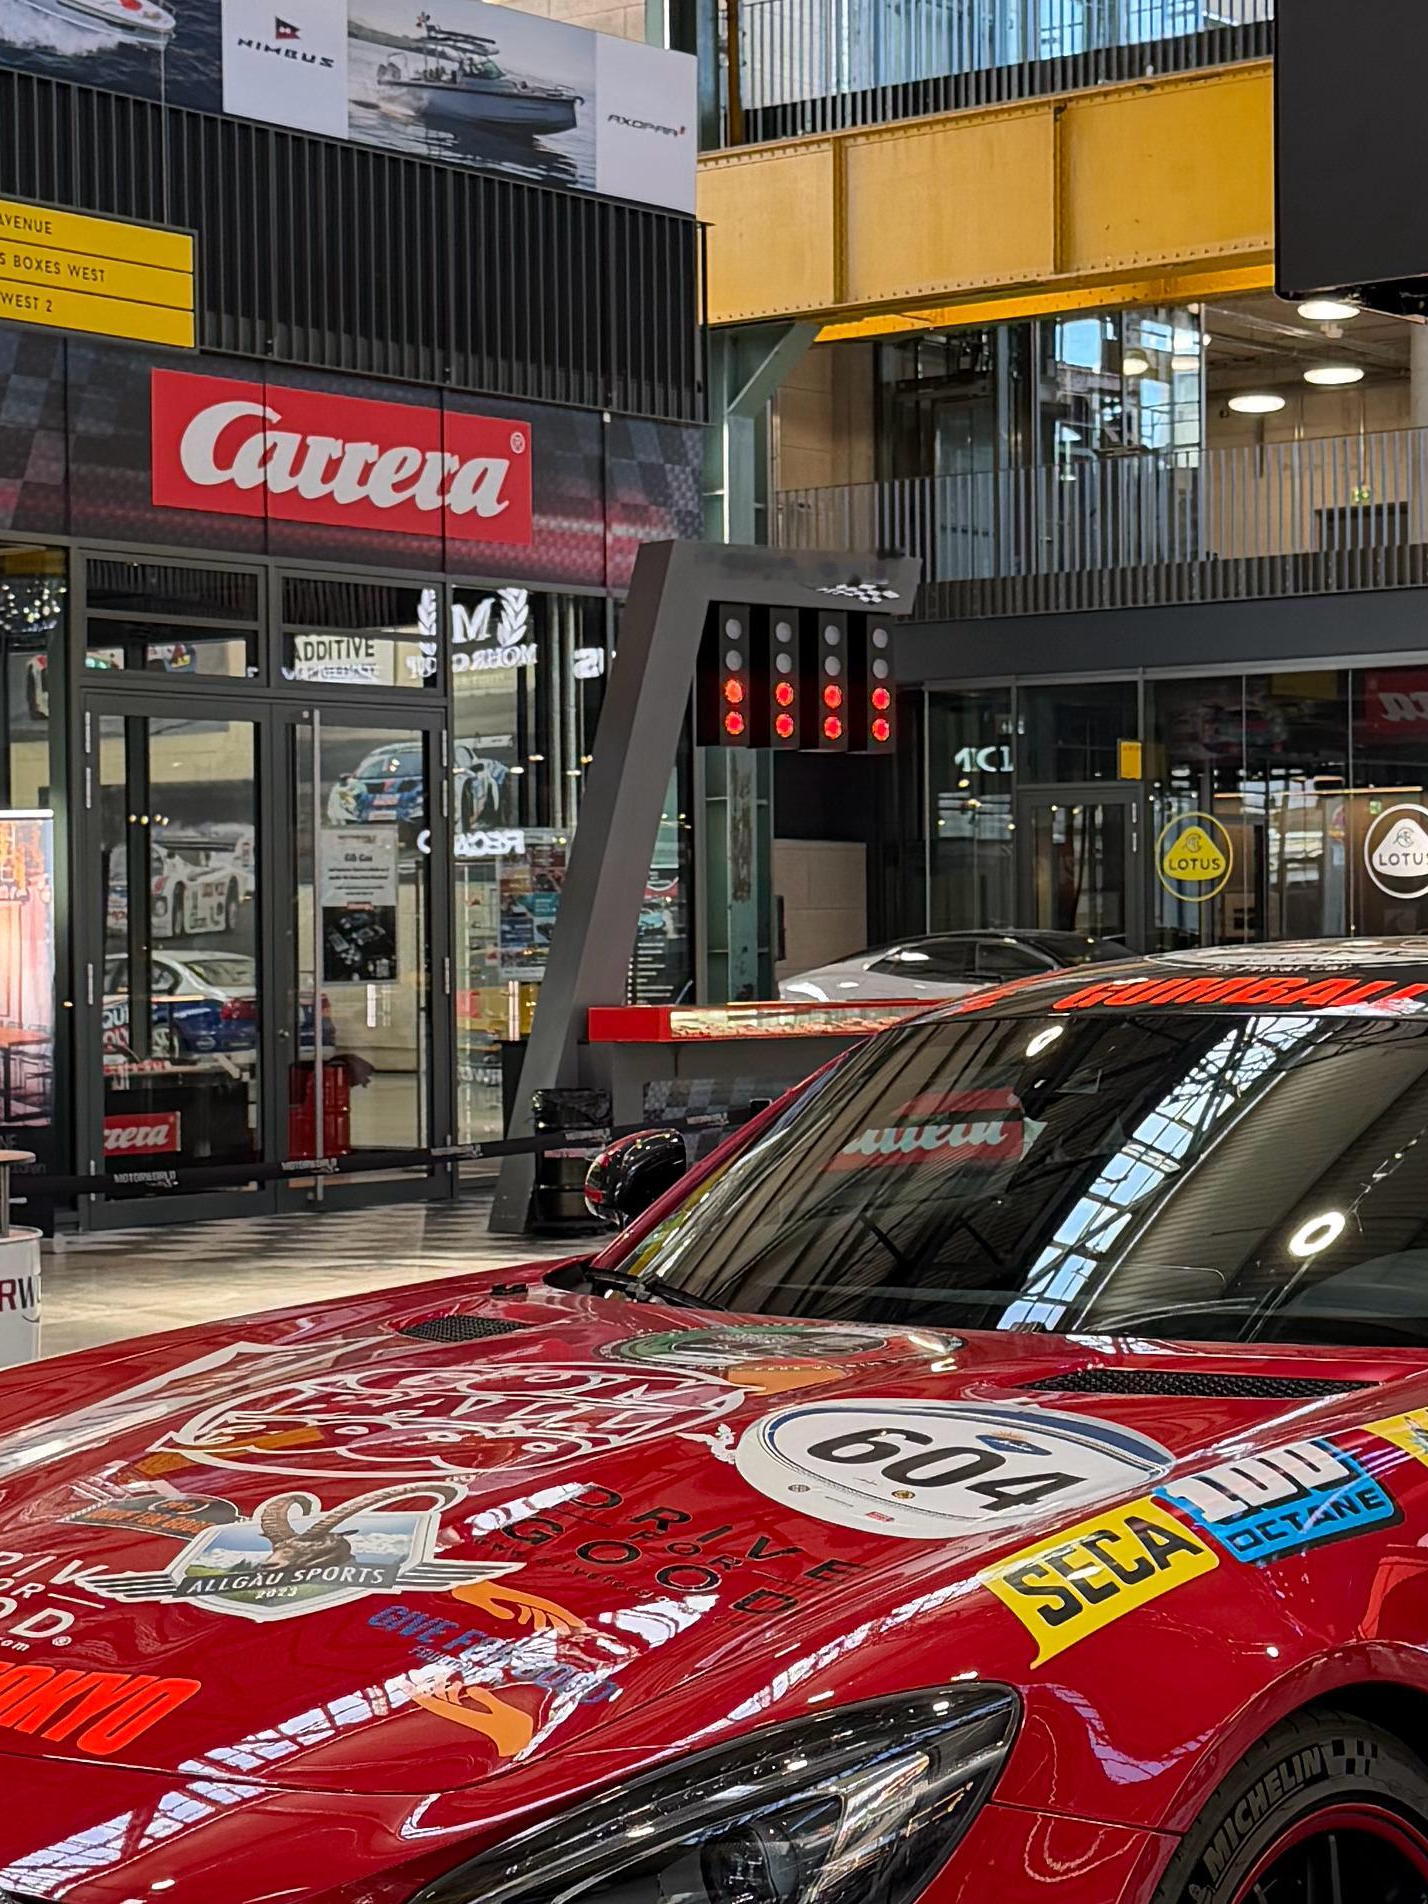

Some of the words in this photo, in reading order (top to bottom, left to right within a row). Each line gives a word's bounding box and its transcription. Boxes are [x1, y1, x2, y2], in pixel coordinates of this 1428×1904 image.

[237, 37, 335, 69] NIMBUS
[13, 254, 62, 276] BOXES
[67, 263, 108, 284] WEST
[0, 290, 41, 313] WEST
[45, 299, 54, 314] 2
[180, 400, 510, 519] Carrera
[294, 636, 375, 663] ADDITIVE
[1168, 856, 1222, 874] LOTUS
[114, 1169, 177, 1184] MOTORWORLD
[807, 1427, 1089, 1513] 604
[571, 1482, 866, 1584] DRIVE
[1225, 1486, 1389, 1553] OCTANE
[187, 1569, 285, 1596] ALLGÄU
[293, 1563, 386, 1585] SPORTS
[501, 1517, 799, 1616] GOOD
[1010, 1513, 1204, 1627] SECA
[1202, 1743, 1325, 1890] MICHELIN
